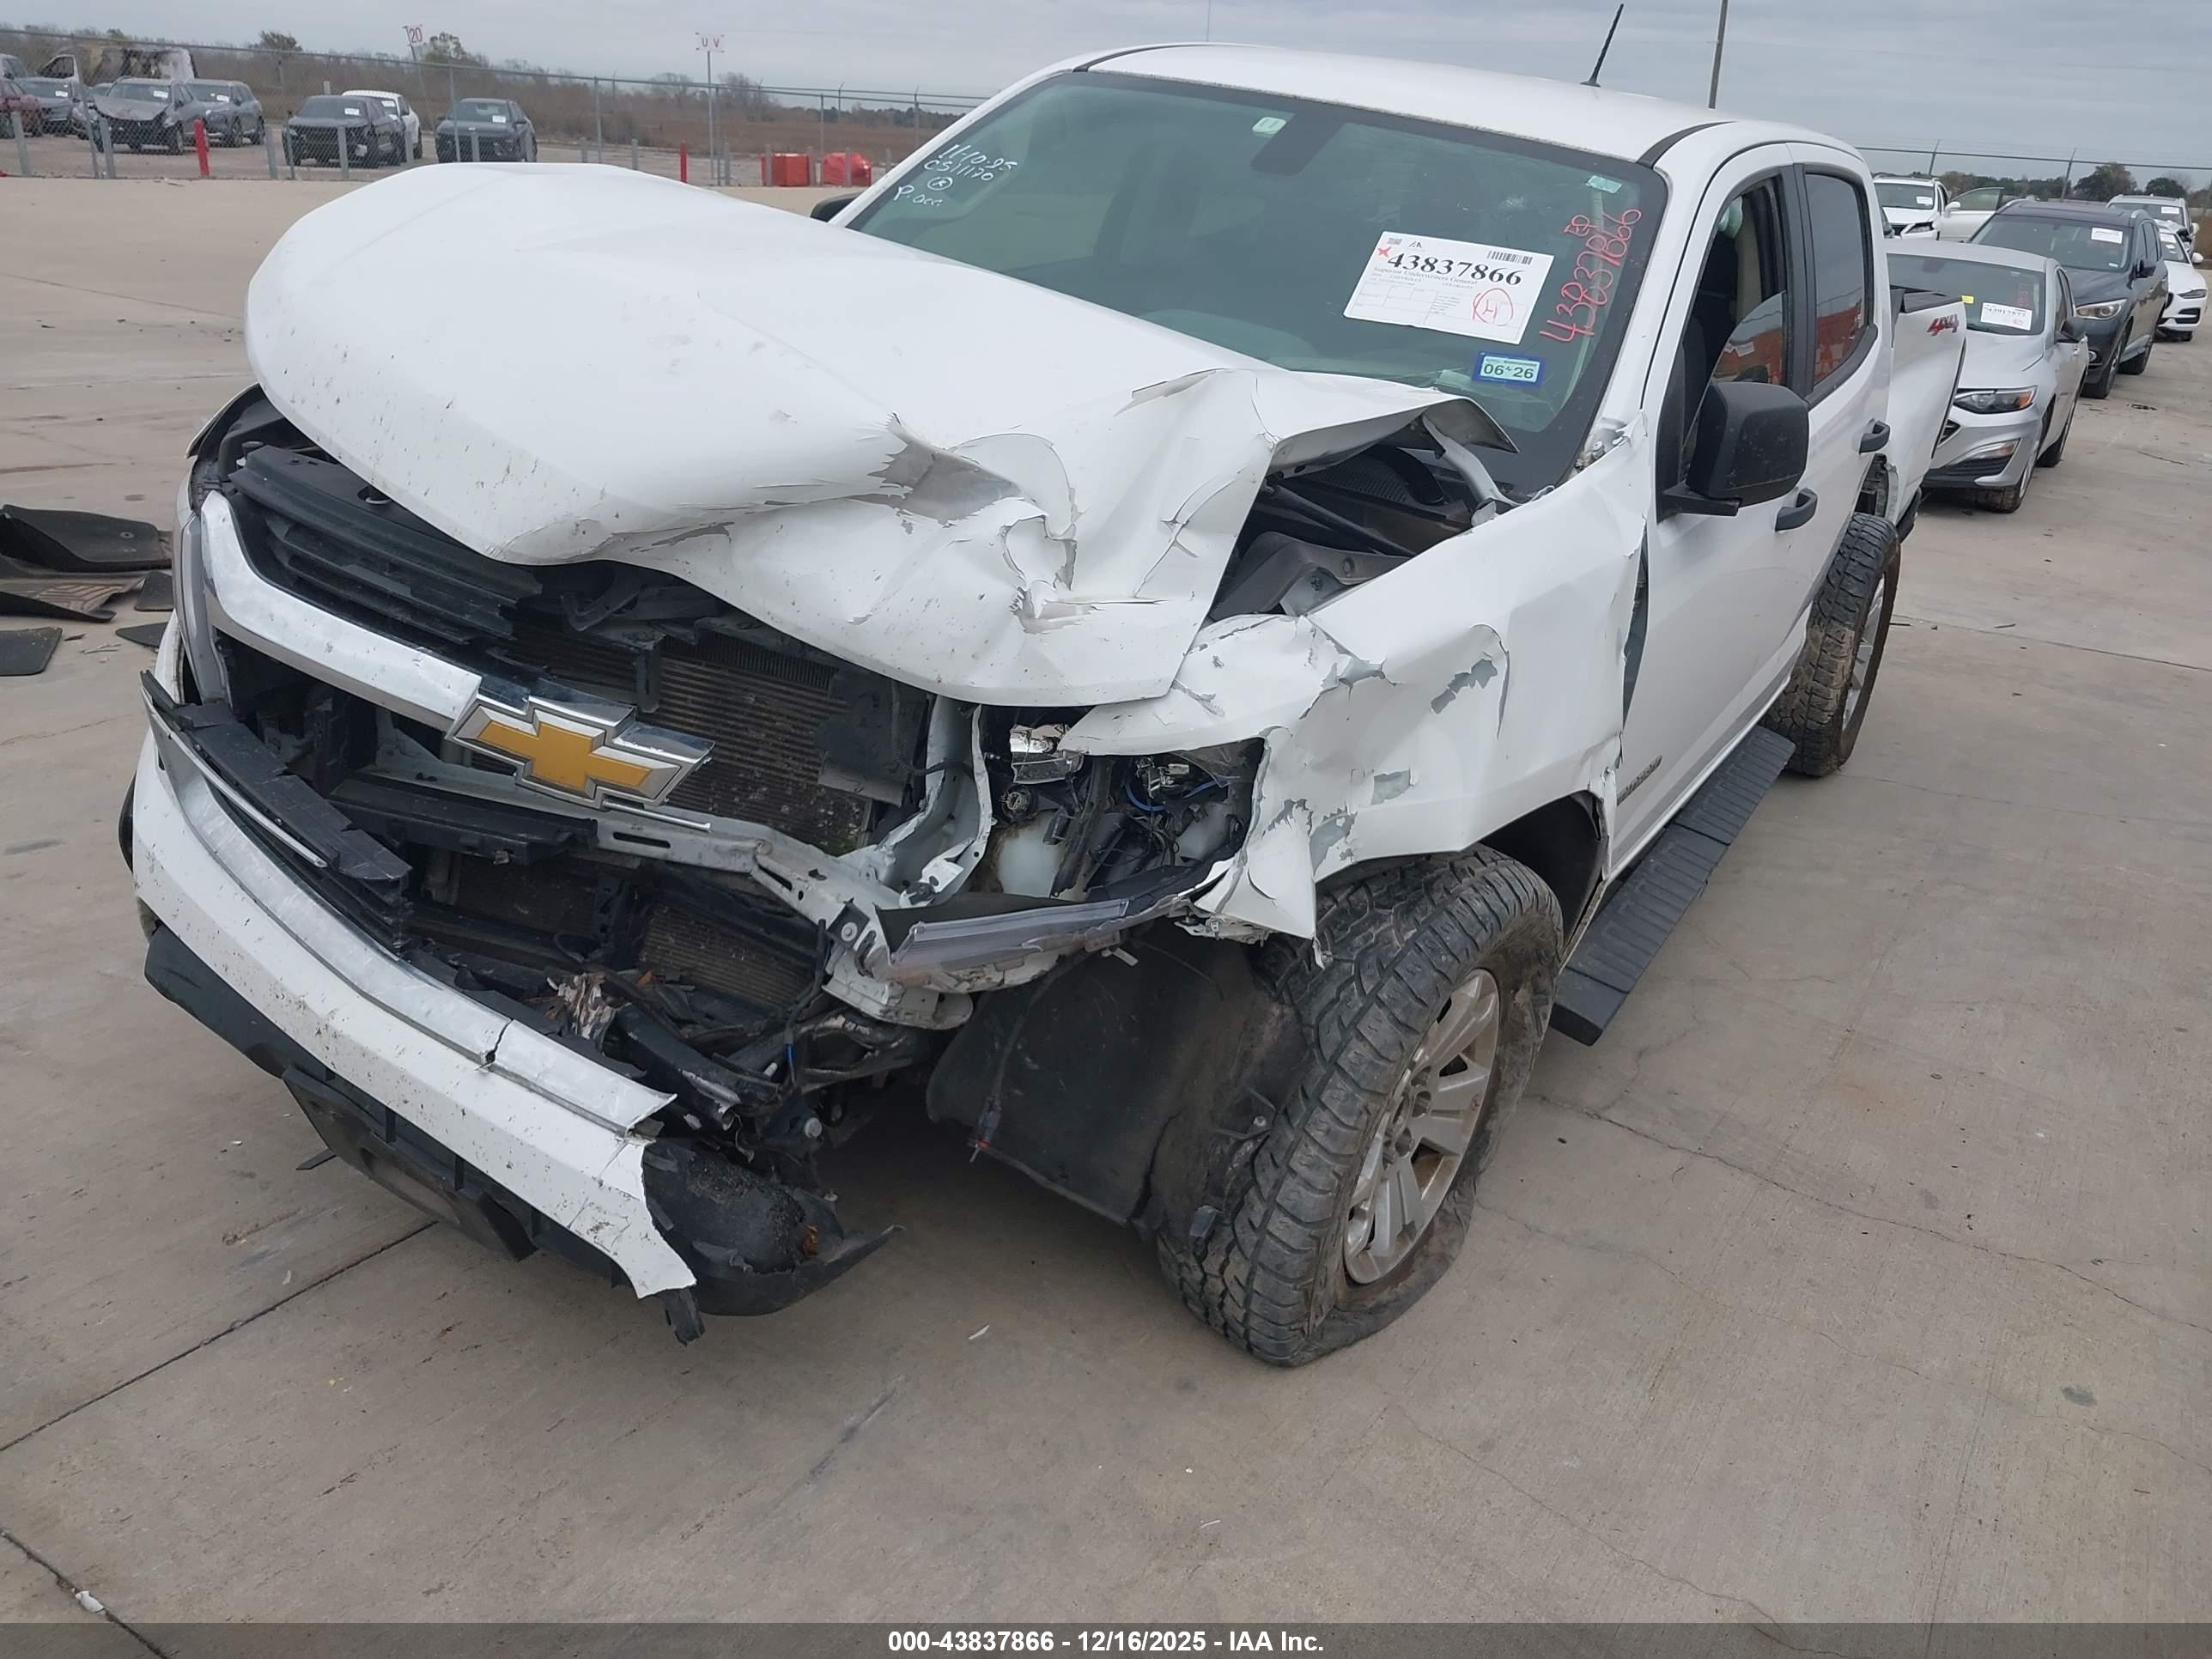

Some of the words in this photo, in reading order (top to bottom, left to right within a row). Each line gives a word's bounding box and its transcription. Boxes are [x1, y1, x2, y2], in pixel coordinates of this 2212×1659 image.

[702, 37, 708, 48] U
[714, 37, 720, 48] V
[1387, 252, 1525, 286] 43837866
[1539, 209, 1642, 342] 43837866
[1484, 363, 1504, 375] 06
[1512, 367, 1534, 379] 26
